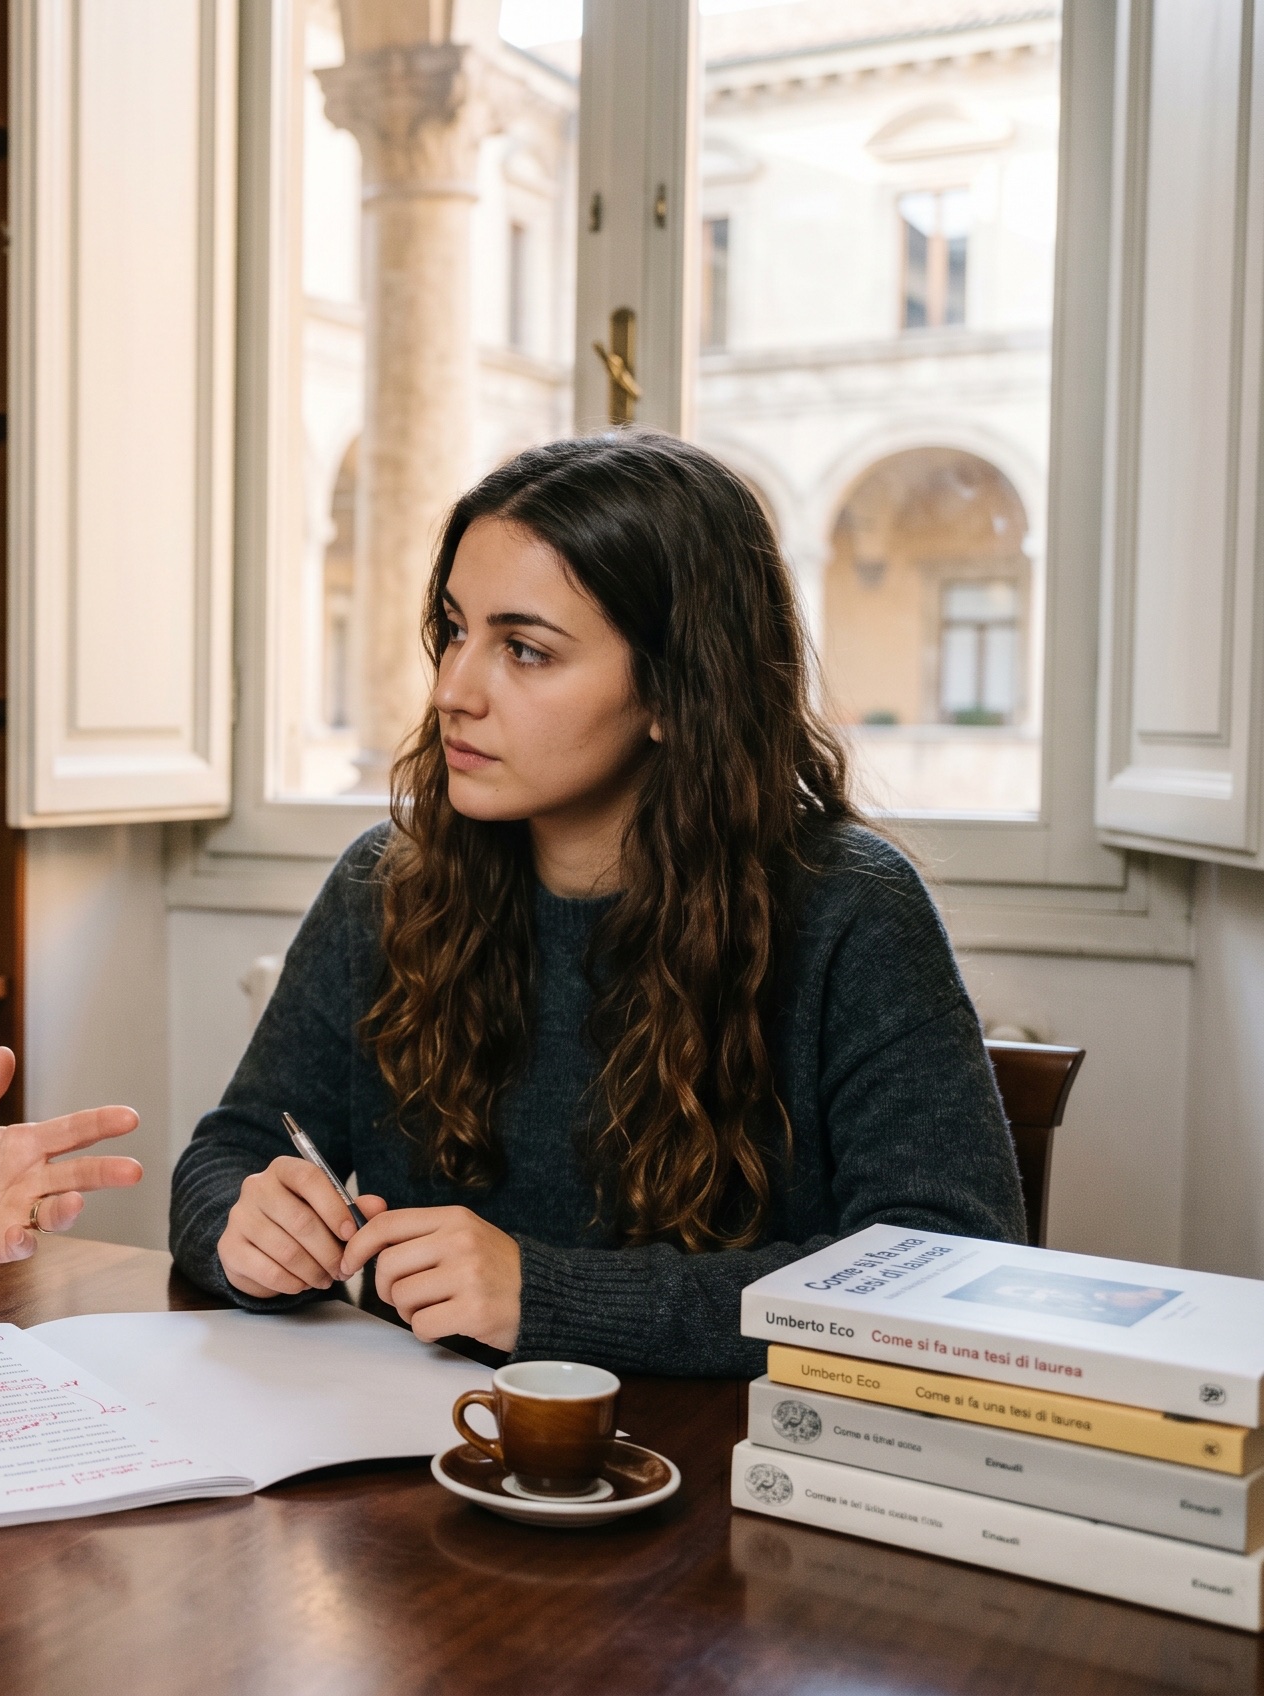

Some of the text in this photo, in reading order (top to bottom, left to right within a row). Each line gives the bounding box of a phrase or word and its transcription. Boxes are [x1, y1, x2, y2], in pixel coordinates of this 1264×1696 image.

[804, 1238, 926, 1291] Come si fa una
[845, 1246, 953, 1294] tesi di laurea
[765, 1311, 1083, 1378] Umberto Eco Come si fa una tesi di laurea
[801, 1364, 1092, 1431] Umberto Eco Come si fa una tesi di laurea
